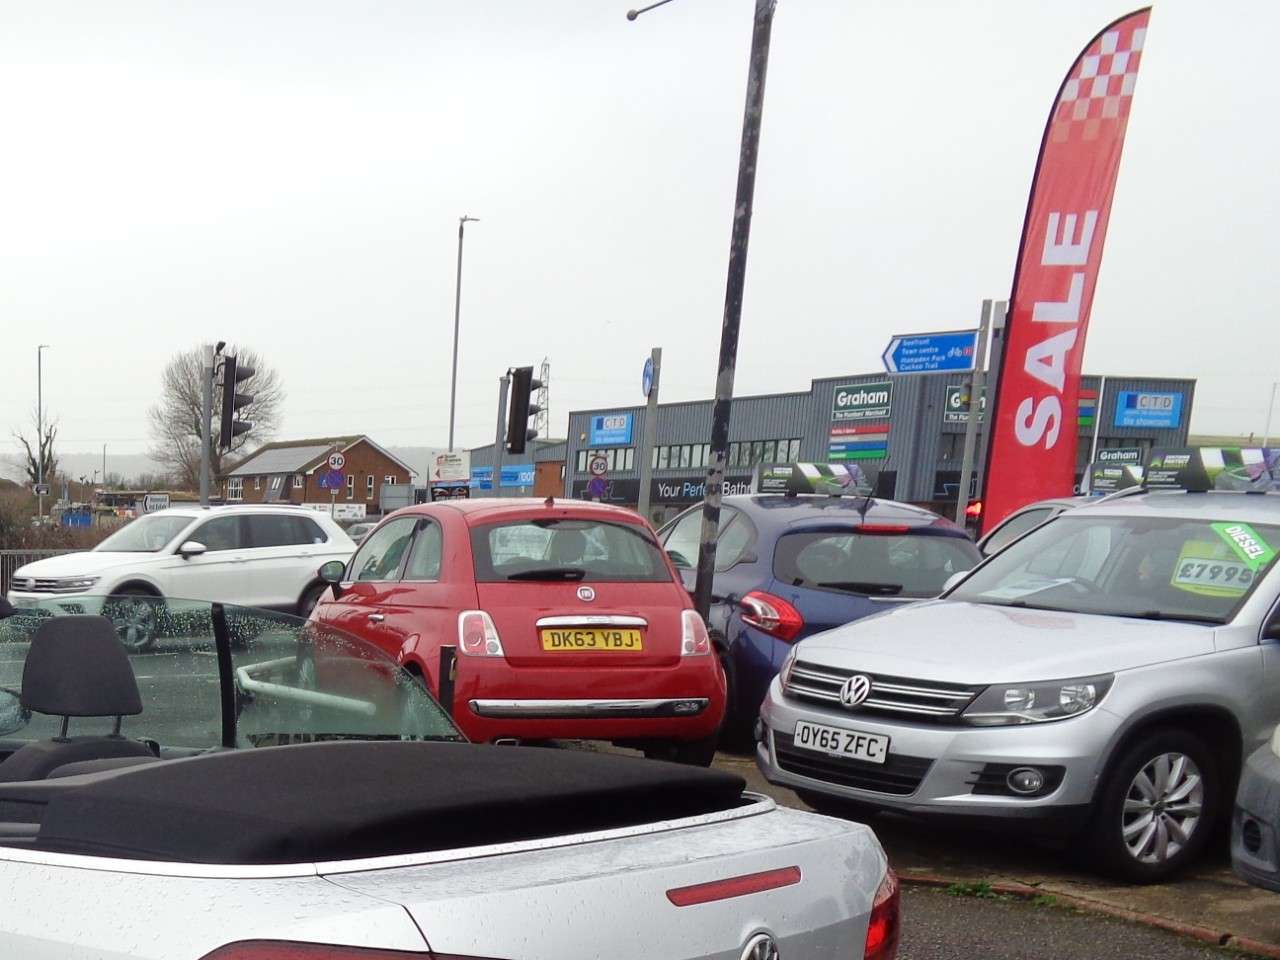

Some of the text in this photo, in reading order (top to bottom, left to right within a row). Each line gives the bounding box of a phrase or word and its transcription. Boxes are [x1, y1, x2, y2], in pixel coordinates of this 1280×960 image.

[1014, 209, 1100, 451] SALE
[837, 389, 889, 407] Graham
[330, 456, 344, 466] 30
[1099, 451, 1138, 460] Graham
[592, 461, 606, 471] 30
[657, 482, 681, 497] Your
[721, 479, 752, 496] Bathr
[1224, 525, 1265, 560] DIESEL
[1179, 562, 1253, 583] £7995
[550, 631, 635, 648] DK63 YBJ
[800, 724, 879, 758] OY65 ZFC
